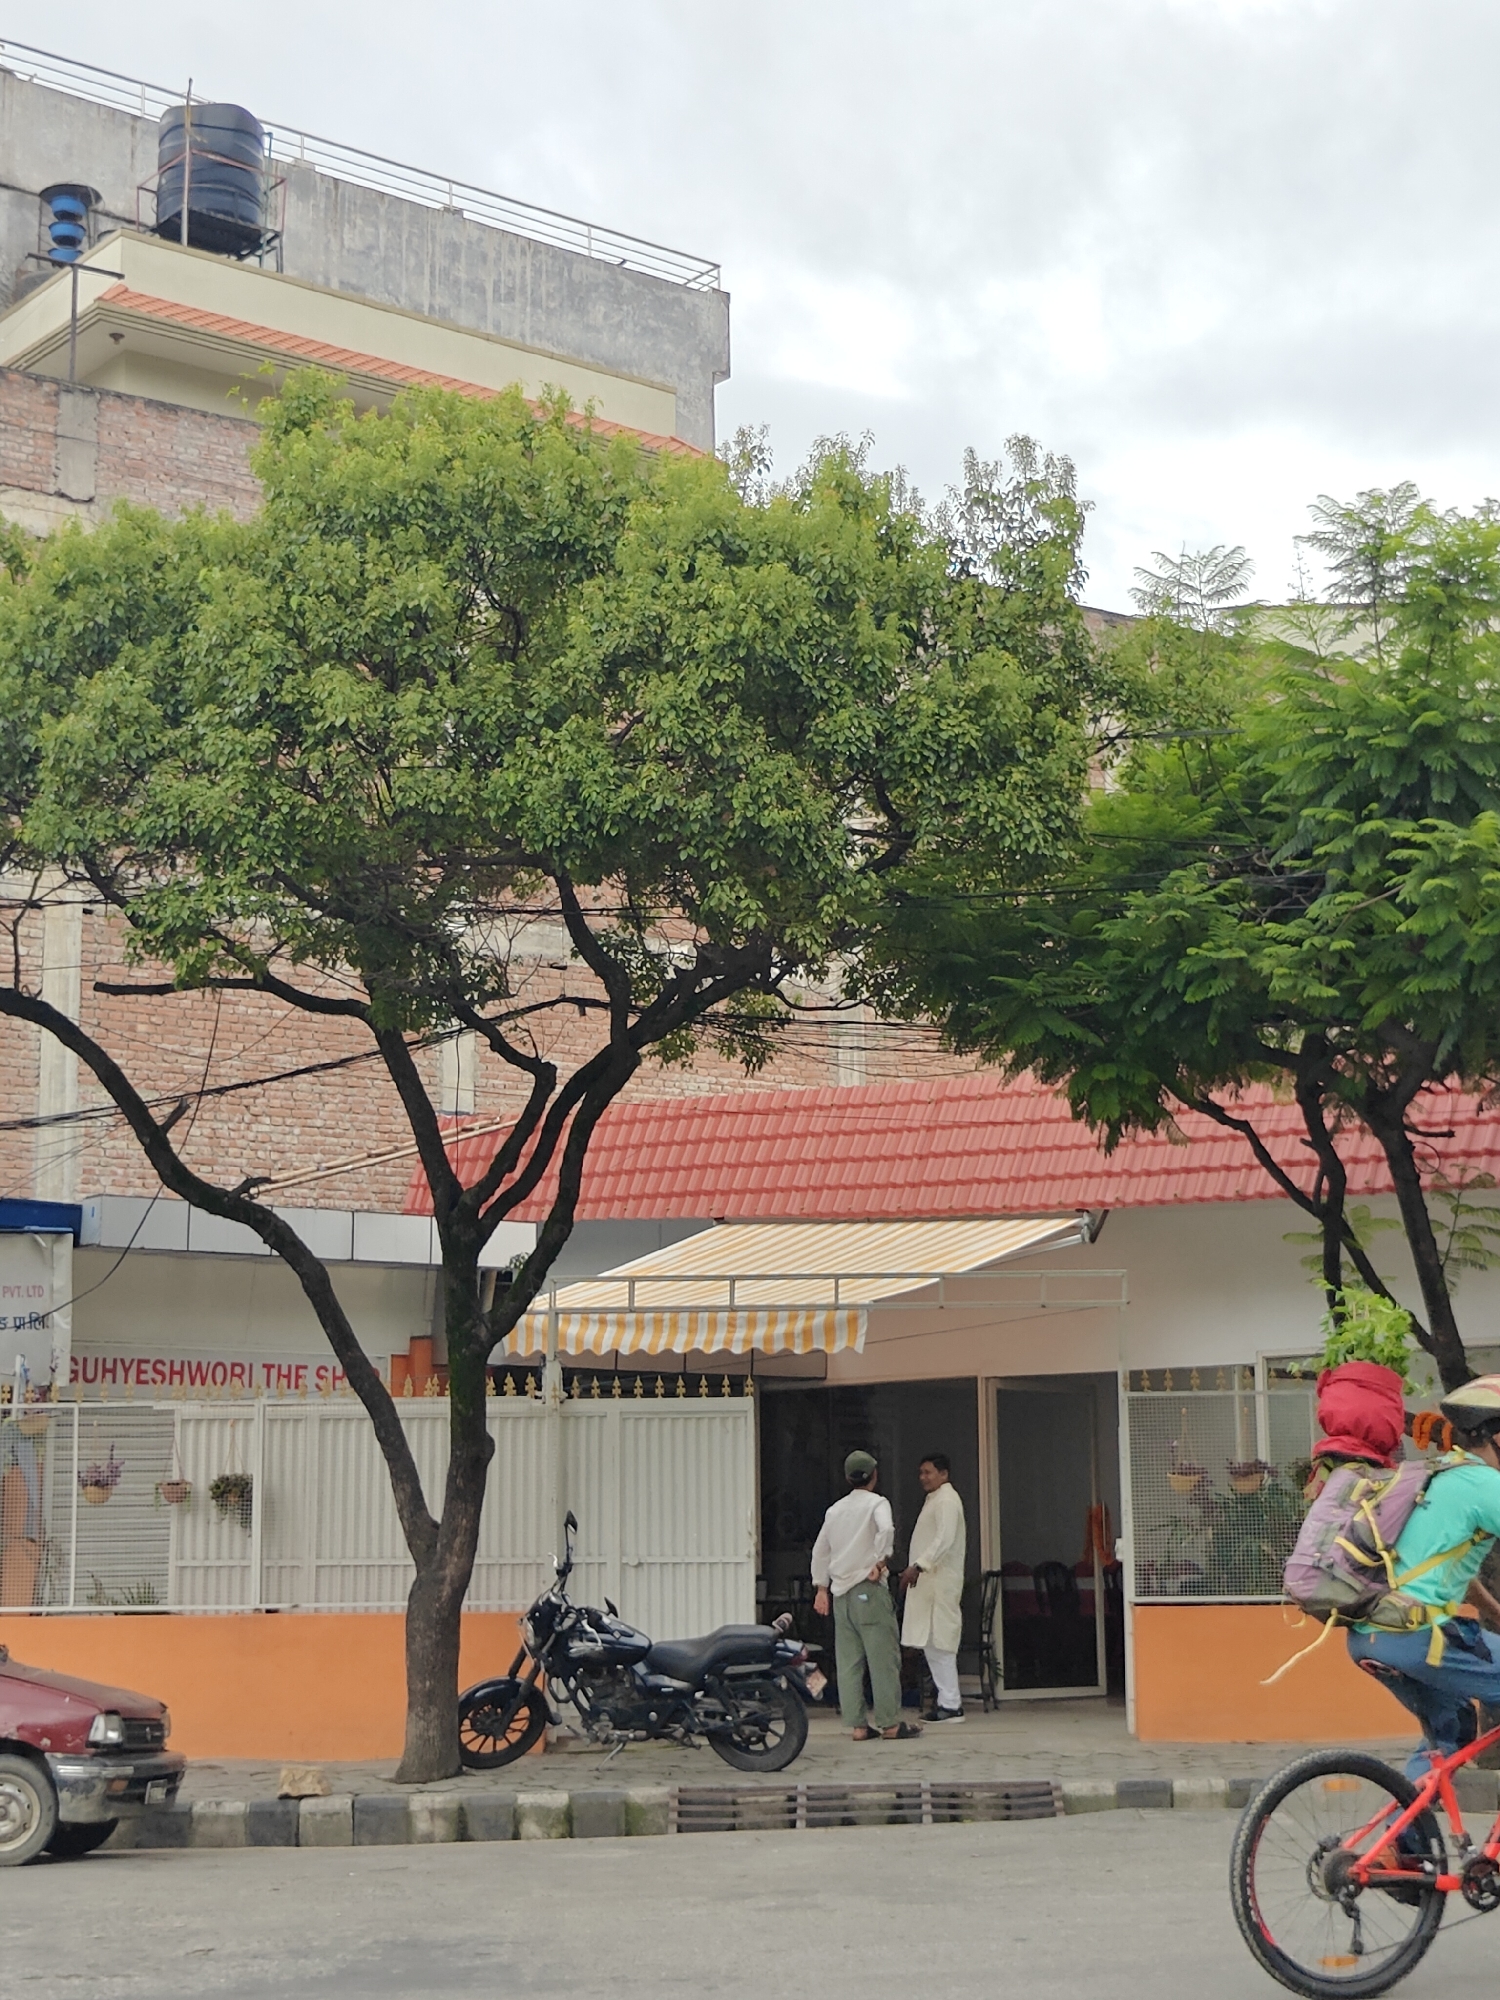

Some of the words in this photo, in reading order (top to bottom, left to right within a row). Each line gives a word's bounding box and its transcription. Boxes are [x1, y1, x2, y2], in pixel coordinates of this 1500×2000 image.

[26, 1284, 45, 1298] LTD
[69, 1355, 254, 1388] GUHYESHWORI
[262, 1361, 309, 1391] THE
